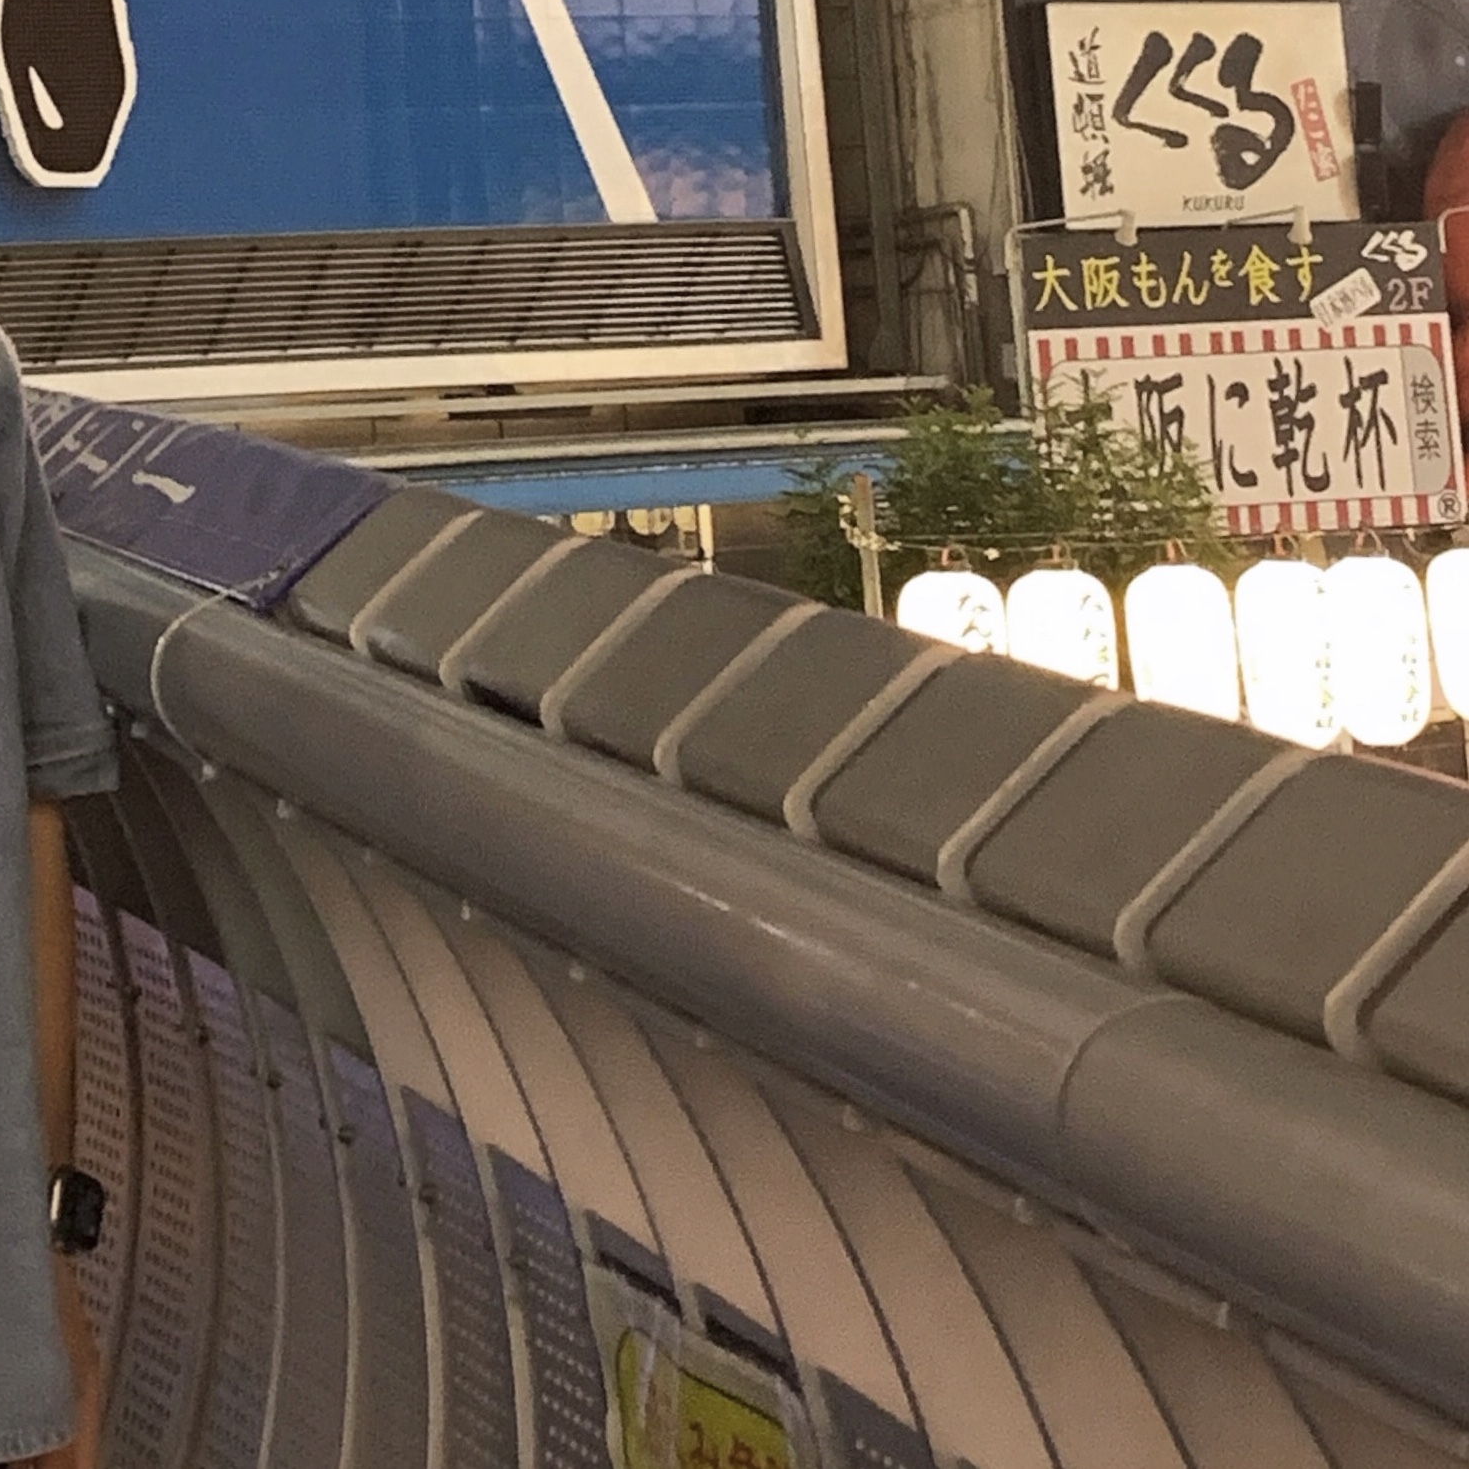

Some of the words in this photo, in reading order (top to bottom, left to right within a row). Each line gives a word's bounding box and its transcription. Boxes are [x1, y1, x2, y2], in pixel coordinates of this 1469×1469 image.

[1112, 31, 1295, 190] くくる
[1182, 195, 1245, 213] KUKURU
[1033, 244, 1324, 312] 大阪もんを食す
[1387, 277, 1432, 312] 2F
